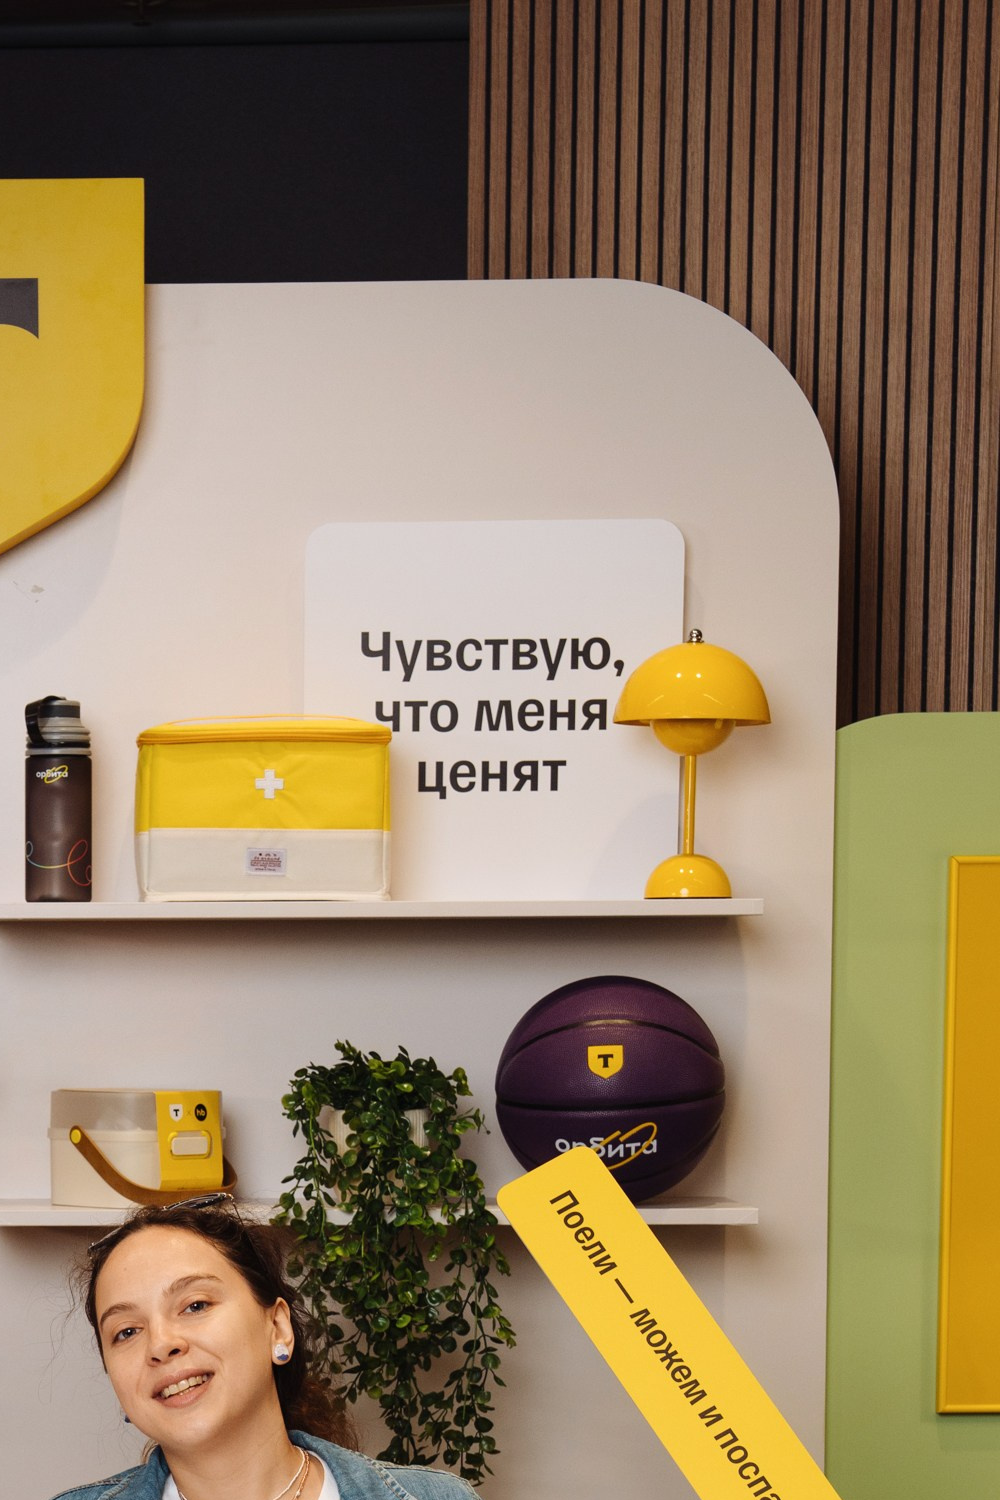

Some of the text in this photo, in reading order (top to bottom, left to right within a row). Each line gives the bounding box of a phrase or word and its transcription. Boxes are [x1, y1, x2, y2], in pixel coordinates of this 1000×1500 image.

[361, 631, 625, 682] Чувствую,
[375, 698, 608, 732] что меня
[35, 768, 69, 781] орбита
[417, 760, 567, 799] ценят
[550, 1190, 617, 1276] Поели
[629, 1308, 708, 1406] можем
[698, 1405, 724, 1428] и
